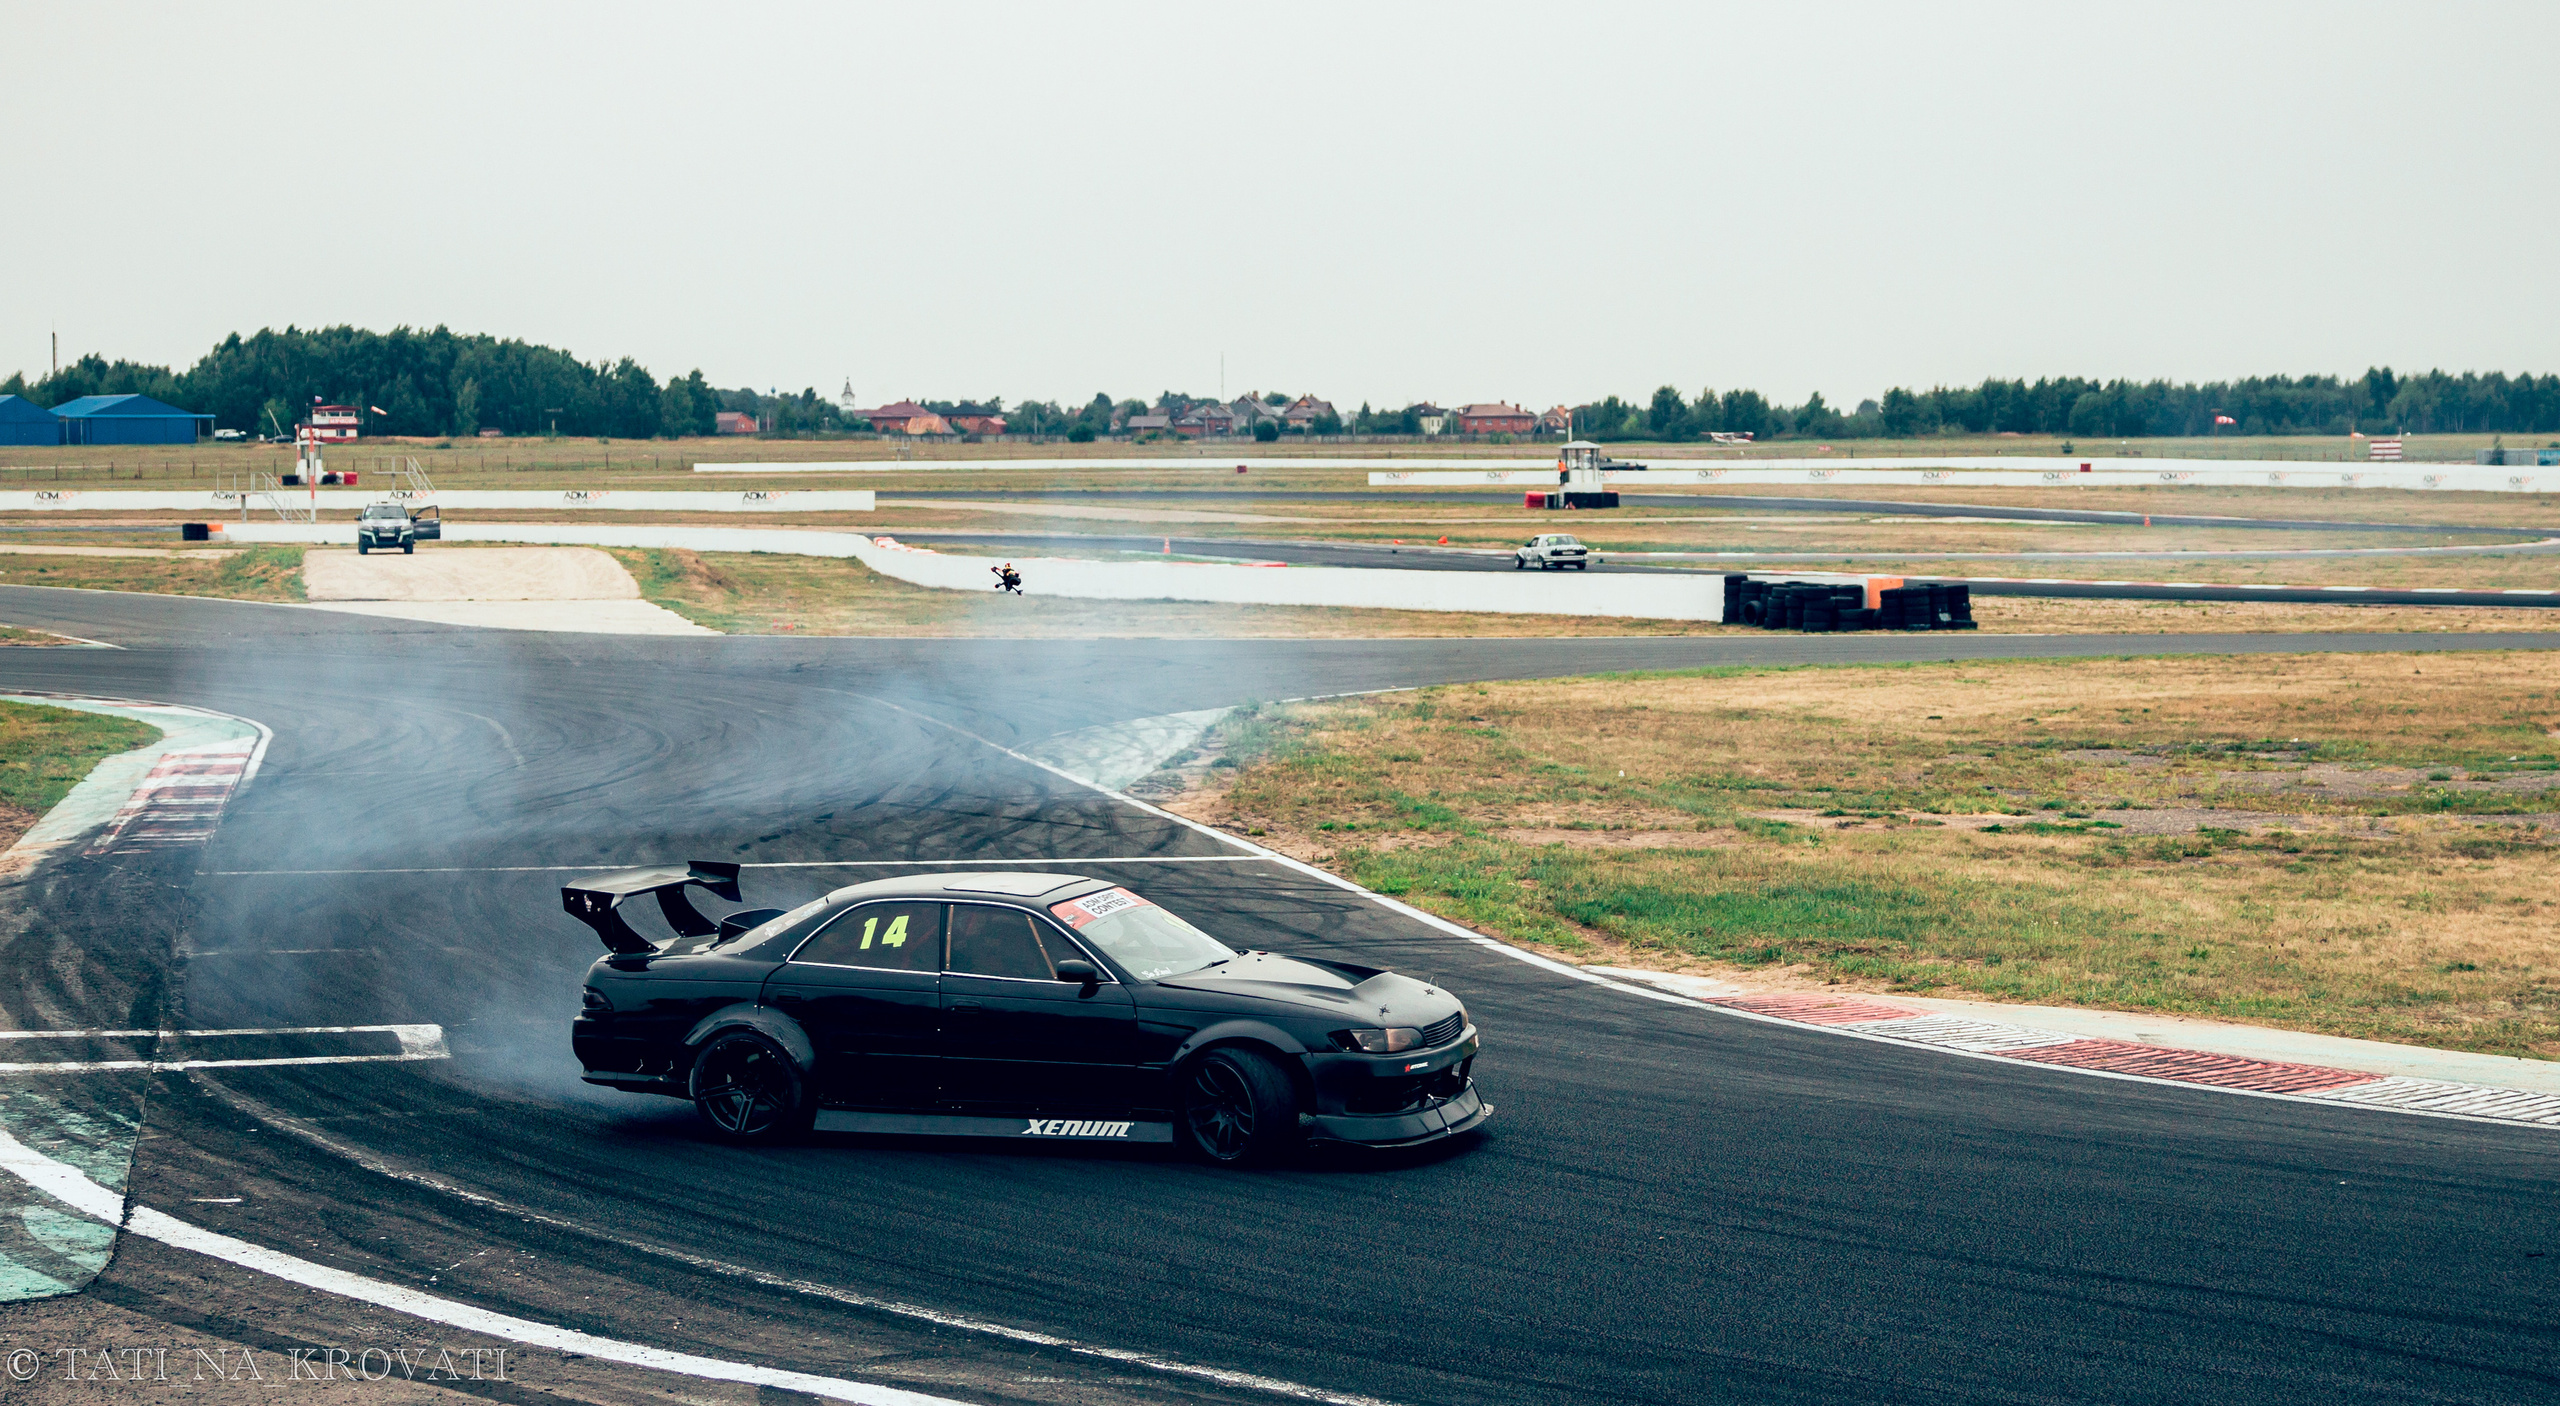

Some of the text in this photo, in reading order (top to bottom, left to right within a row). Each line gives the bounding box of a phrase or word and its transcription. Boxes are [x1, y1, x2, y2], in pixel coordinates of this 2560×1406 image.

[34, 491, 59, 500] ADM
[389, 491, 413, 500] ADM
[563, 491, 588, 500] ADM
[742, 491, 767, 500] ADM
[1082, 897, 1101, 908] ADM
[1091, 897, 1130, 914] CONTEST
[860, 915, 909, 949] 14
[1021, 1119, 1131, 1137] XENUM
